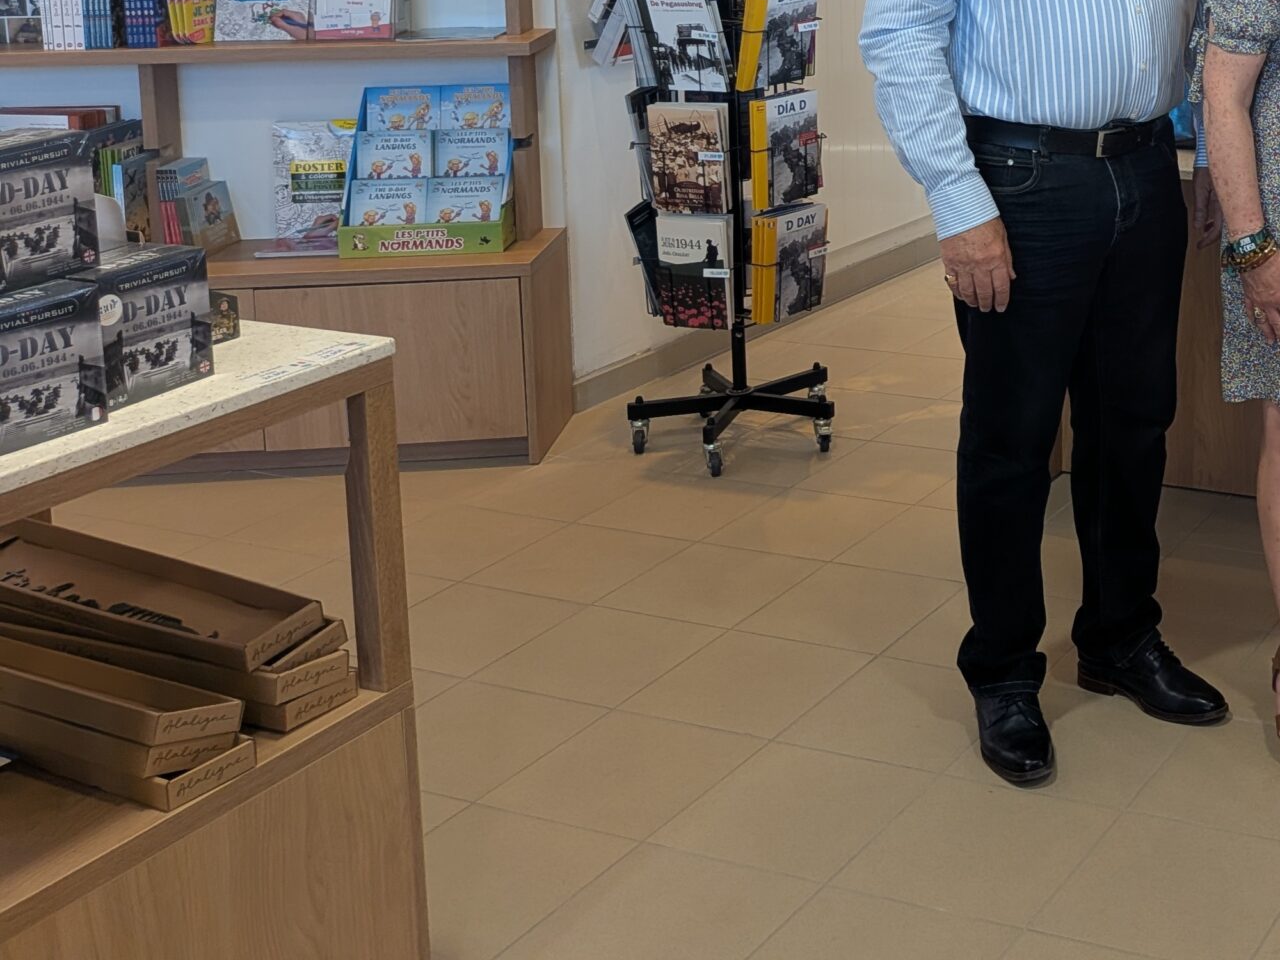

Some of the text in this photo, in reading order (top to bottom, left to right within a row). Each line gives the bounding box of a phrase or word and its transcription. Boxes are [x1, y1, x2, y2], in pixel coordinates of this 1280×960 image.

[777, 100, 807, 115] DÍA D
[375, 143, 417, 151] LANDINGS
[447, 136, 497, 145] NORMANDS
[0, 149, 69, 170] RIVIAL PURSUIT
[295, 162, 344, 172] POSTER
[0, 168, 70, 206] D-DAY
[368, 192, 412, 200] LANDINGS
[441, 186, 491, 194] NORMANDS
[10, 194, 64, 215] 06.06.1944
[786, 213, 817, 231] D DAY
[395, 229, 447, 239] LES P'TITS
[675, 238, 702, 250] 1944
[380, 239, 463, 252] NORMANDS
[119, 266, 187, 290] TRIVIAL PURSUIT
[122, 284, 189, 324] D-DAY
[0, 305, 74, 330] IVIAL PURSUIT
[133, 310, 182, 332] 06.06.1944
[2, 353, 67, 378] 06.06.1944
[281, 665, 341, 693] Alaligne
[295, 688, 353, 720] Alaligne
[163, 714, 234, 734] Alaligne
[153, 744, 225, 765] Alaligne
[177, 757, 248, 797] Alaligne
